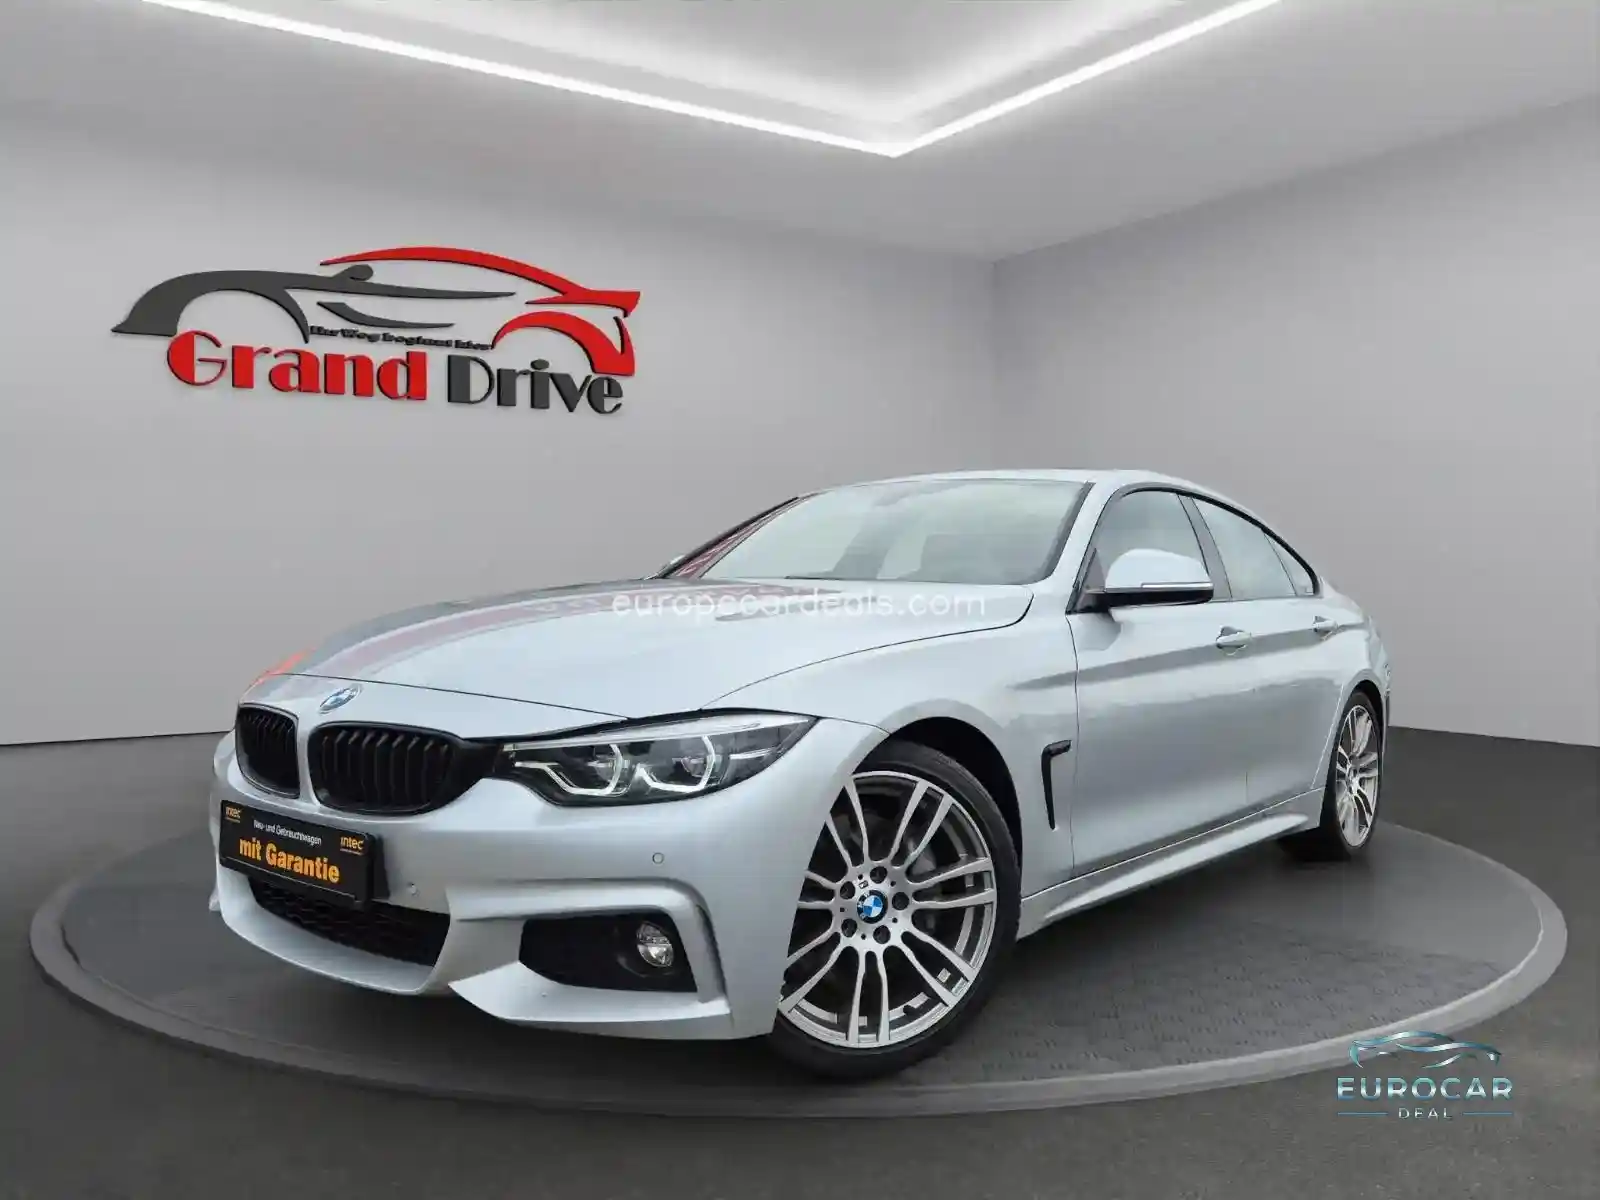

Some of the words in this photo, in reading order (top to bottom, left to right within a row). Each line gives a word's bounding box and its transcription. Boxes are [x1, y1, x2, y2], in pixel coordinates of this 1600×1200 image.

[166, 330, 428, 401] Grand
[447, 354, 624, 415] Drive
[239, 837, 262, 861] mit
[265, 842, 340, 883] Garantie
[340, 836, 363, 850] intec
